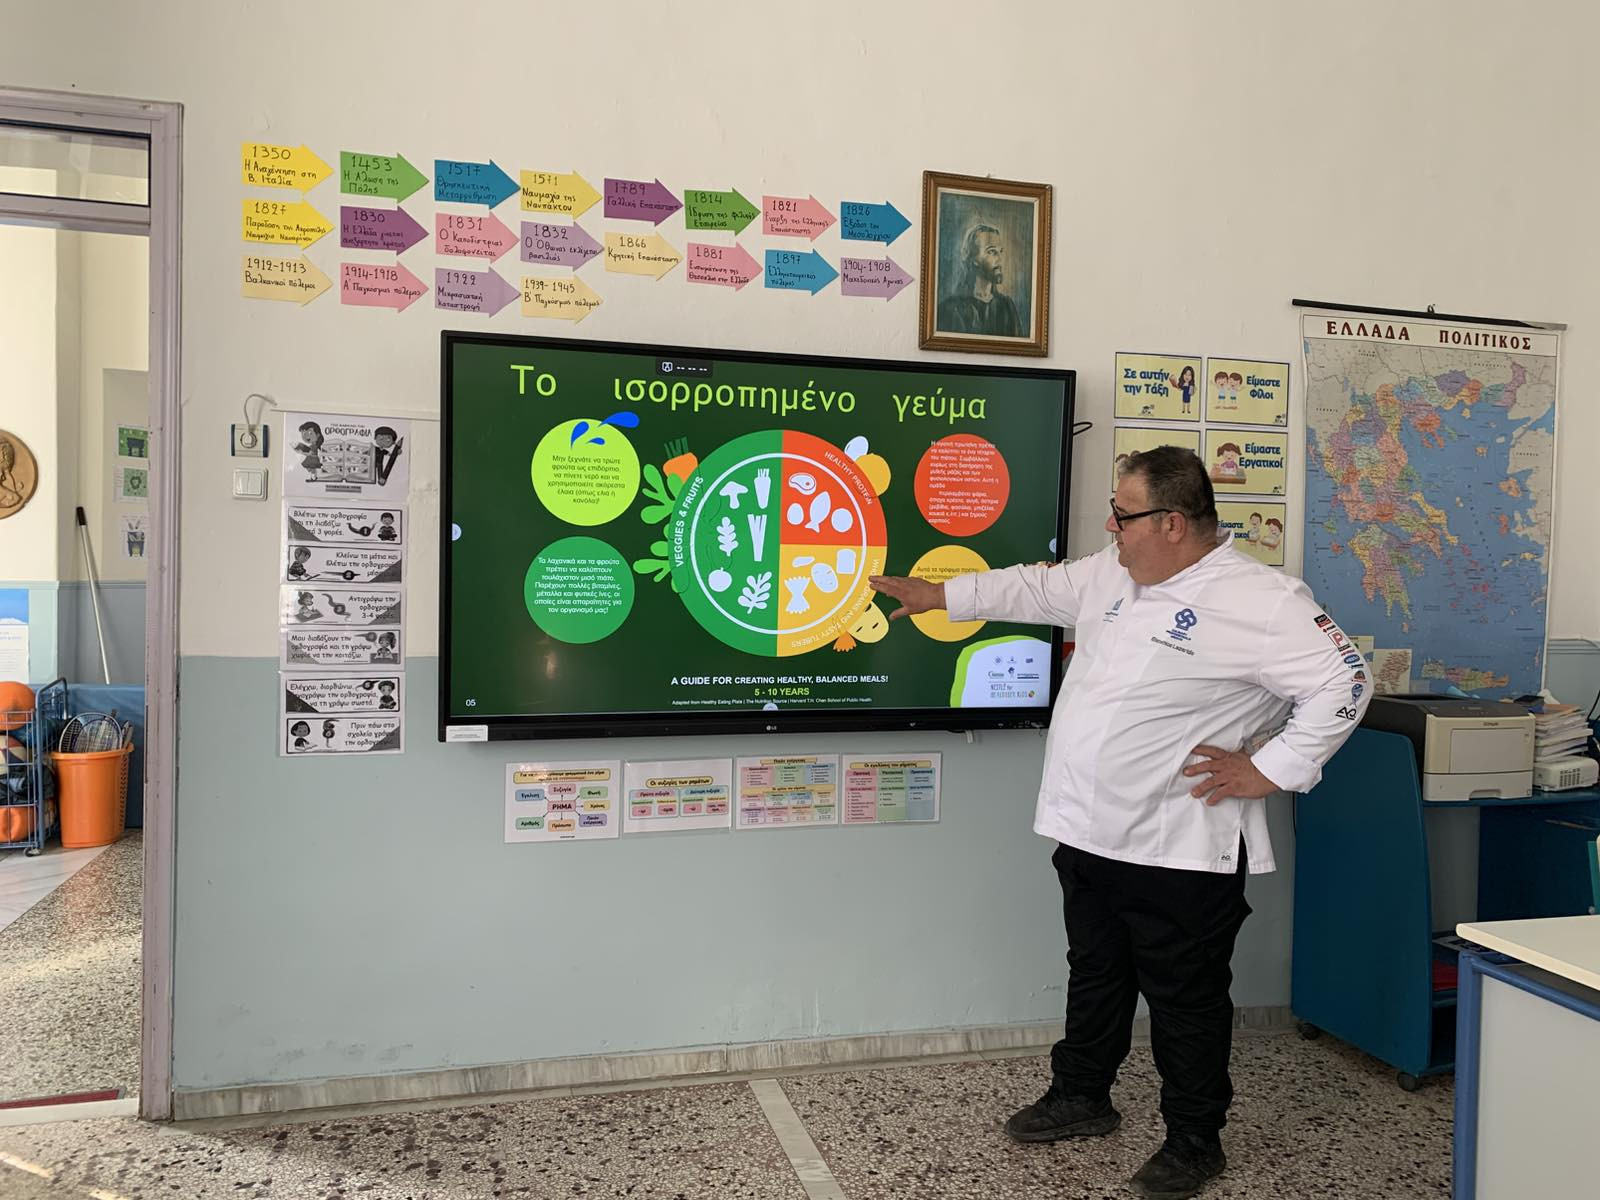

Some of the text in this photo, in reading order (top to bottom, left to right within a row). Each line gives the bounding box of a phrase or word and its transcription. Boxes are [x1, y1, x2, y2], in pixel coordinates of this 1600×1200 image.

[252, 145, 291, 160] 1350
[244, 158, 250, 171] Η
[352, 154, 392, 172] 1453
[448, 162, 481, 176] 1517
[344, 170, 350, 181] Η
[533, 173, 558, 186] 1571
[615, 182, 646, 196] 1789
[563, 194, 576, 202] της
[694, 192, 722, 204] 1814
[254, 202, 287, 216] 1827
[772, 200, 797, 212] 1821
[846, 204, 871, 216] 1826
[353, 210, 386, 223] 1830
[343, 224, 350, 233] Η
[448, 216, 483, 230] 1831
[438, 228, 449, 240] Ο
[534, 224, 569, 240] 1832
[619, 236, 647, 249] 1866
[696, 246, 722, 260] 1881
[776, 252, 801, 264] 1897
[247, 257, 308, 274] 1912-1913
[344, 266, 399, 282] 1914-1918
[446, 271, 476, 286] 1922
[1326, 320, 1532, 350] ΕΛΛΑΔΑ ΠΟΛΙΤΙΚΟΣ
[1124, 368, 1170, 382] Σε αυτήν
[1246, 376, 1281, 388] Είμαστε
[510, 364, 987, 424] Το ισορροπημένο γεύμα
[1123, 384, 1169, 397] την Τάξη
[1250, 388, 1274, 400] Φίλοι
[1245, 442, 1281, 456] Είμαστε
[1238, 456, 1284, 470] Εργατικοί
[824, 450, 874, 506] HEALTHY PROTEIN
[293, 510, 316, 519] Βλέπω
[330, 512, 368, 522] ορθογραφία
[674, 476, 704, 568] VEGGIES & FRUITS
[316, 519, 342, 529] διαβάζω
[336, 552, 359, 560] Κλείνω
[369, 552, 387, 562] μάτια
[547, 558, 576, 566] λαχανικά
[349, 561, 360, 569] την
[348, 596, 384, 605] Αντιγράφω
[308, 634, 339, 644] διαβάζουν
[791, 620, 842, 648] TASTY TUBERS
[351, 644, 372, 652] γράφω
[670, 676, 679, 685] A
[680, 676, 710, 685] GUIDE
[712, 676, 732, 684] FOR
[734, 676, 775, 684] CREATING
[777, 676, 814, 684] HEALTHY,
[328, 691, 339, 699] την
[754, 688, 760, 696] 5
[780, 688, 810, 696] YEARS
[328, 700, 350, 708] γράφω
[466, 699, 476, 707] 05
[350, 722, 366, 730] Πριν
[368, 721, 382, 729] πάω
[347, 730, 373, 739] σχολείο
[552, 803, 572, 811] ΡΗΜΑ
